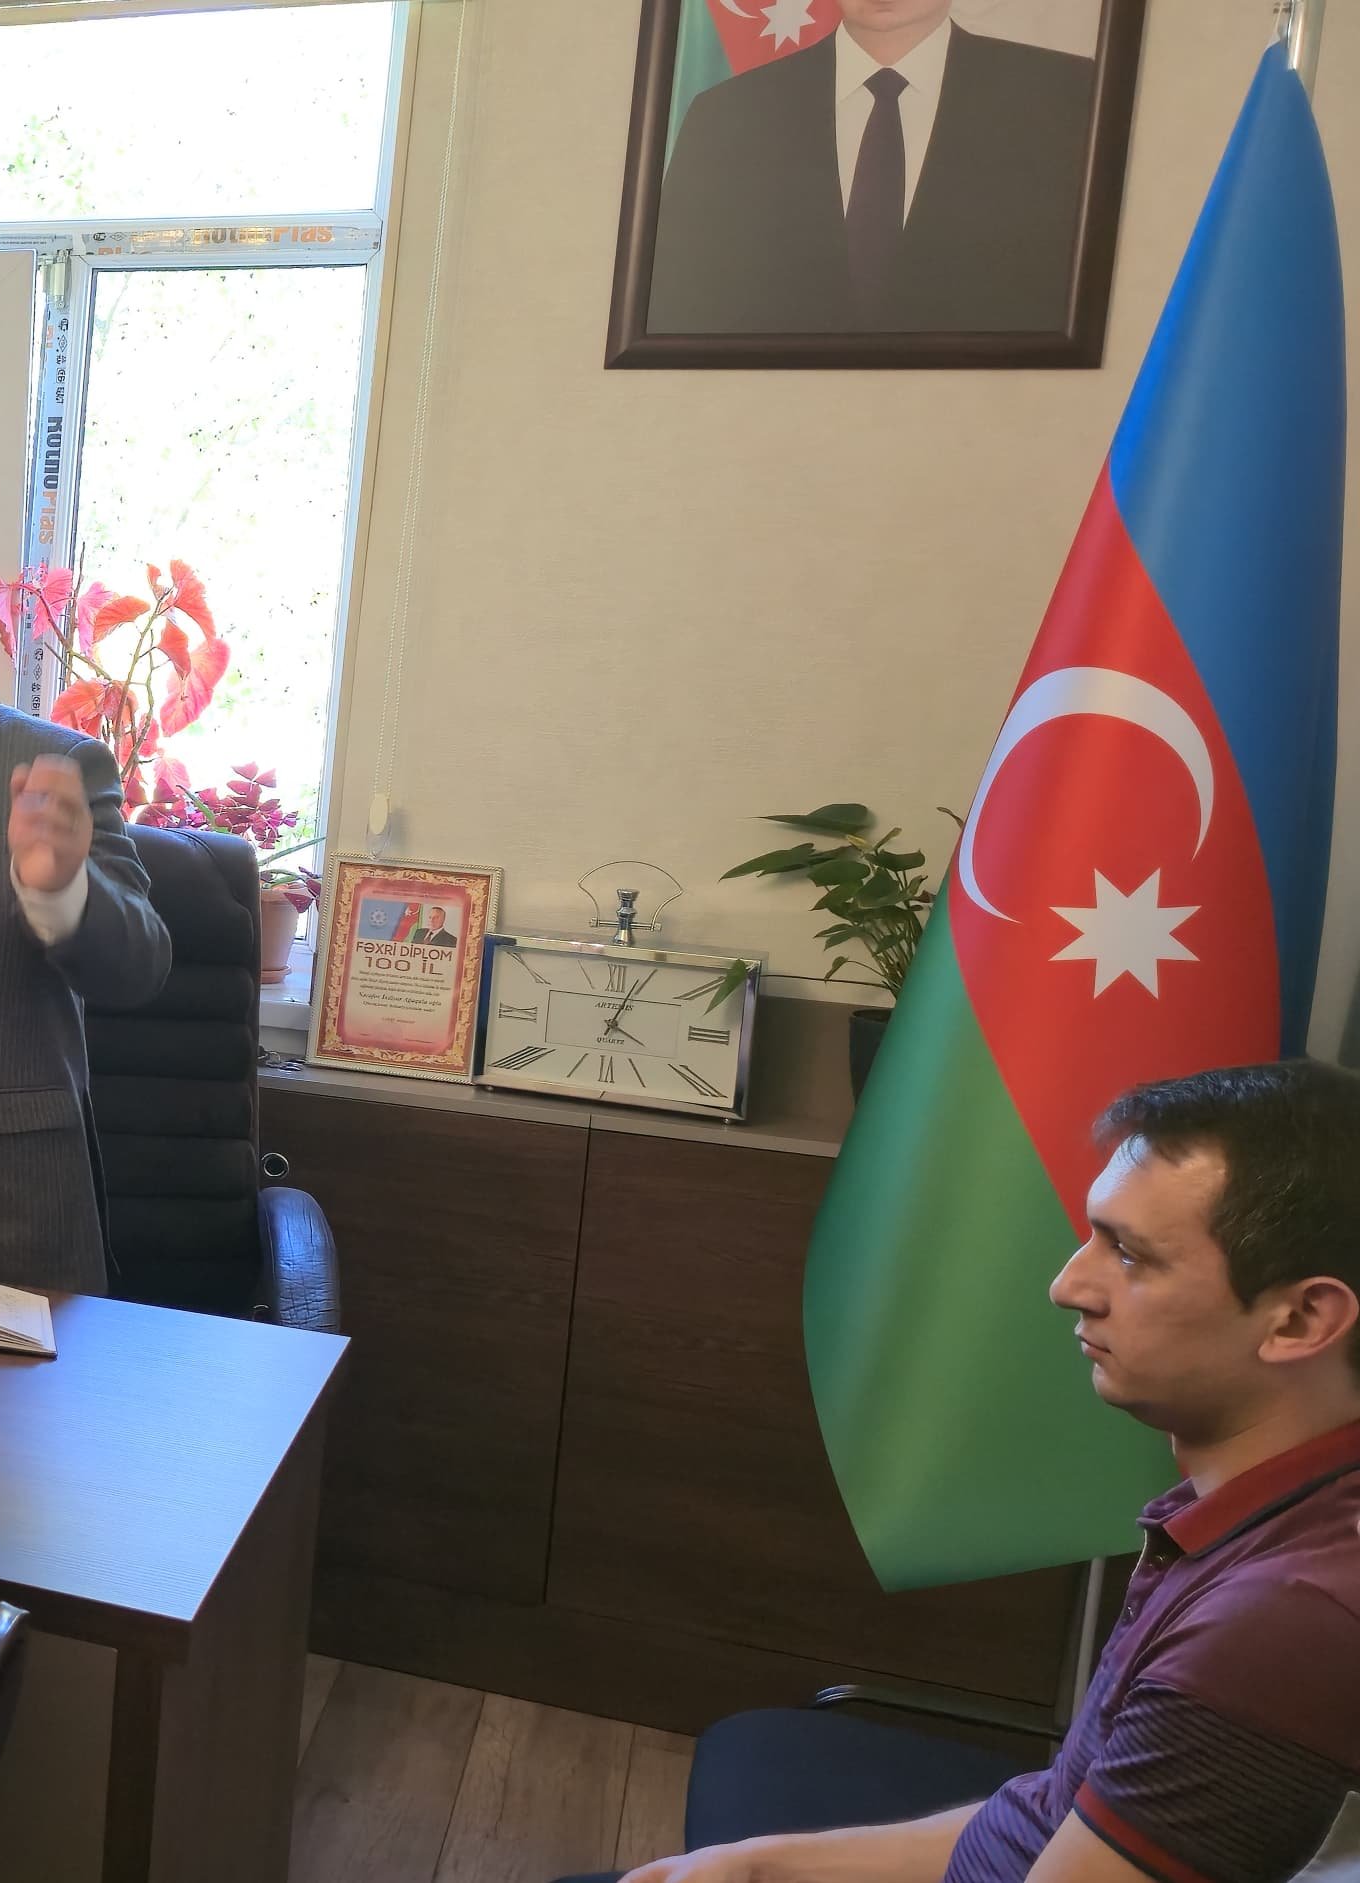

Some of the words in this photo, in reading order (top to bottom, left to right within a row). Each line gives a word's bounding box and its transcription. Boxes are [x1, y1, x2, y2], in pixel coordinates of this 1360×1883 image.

[356, 941, 397, 956] FƏXRİ
[400, 944, 453, 961] DİPLOM
[364, 956, 411, 972] 100
[421, 959, 444, 976] İL
[604, 962, 628, 993] XII
[596, 1036, 625, 1046] QUARTZ
